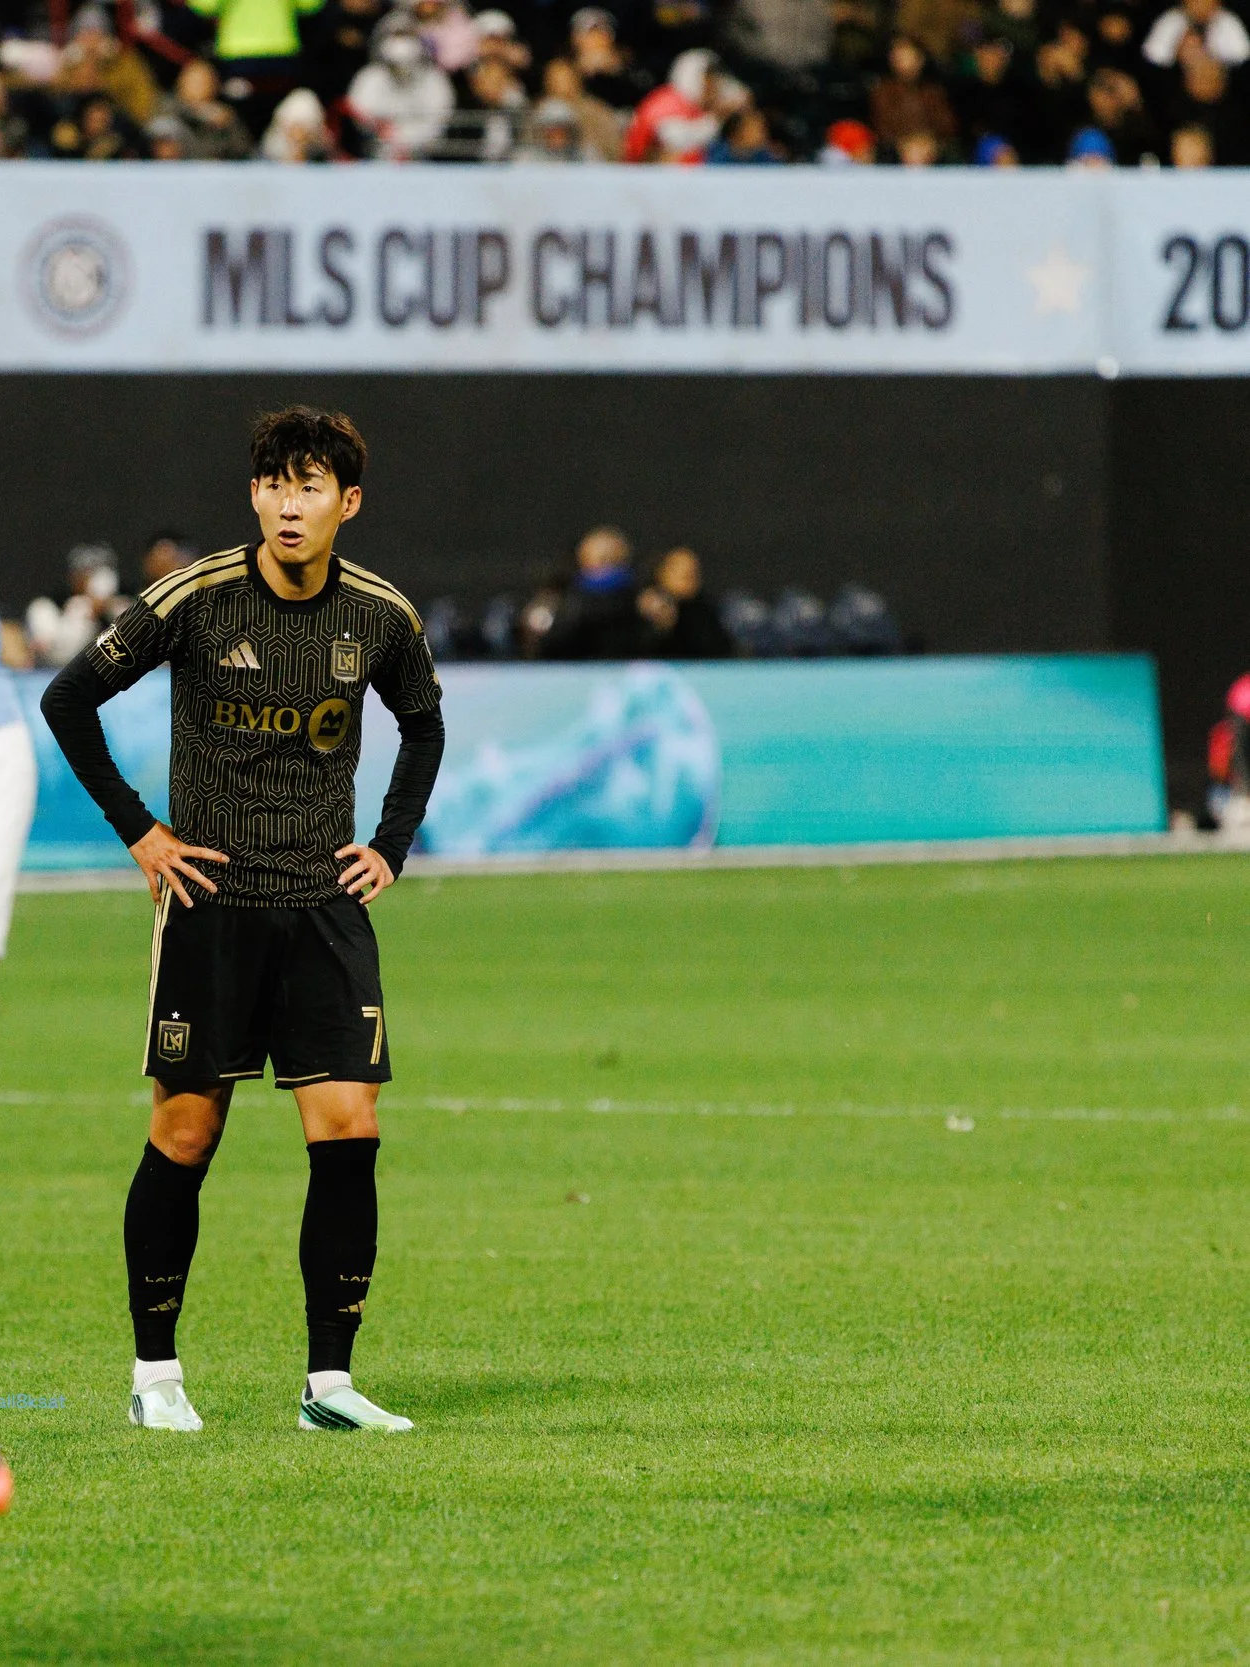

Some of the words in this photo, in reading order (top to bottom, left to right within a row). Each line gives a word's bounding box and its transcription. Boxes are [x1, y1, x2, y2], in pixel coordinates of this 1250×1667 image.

[202, 229, 355, 328] MLS
[378, 229, 511, 329] CUP
[532, 230, 954, 330] CHAMPIONS
[211, 699, 301, 734] BMO
[361, 1006, 383, 1065] 7
